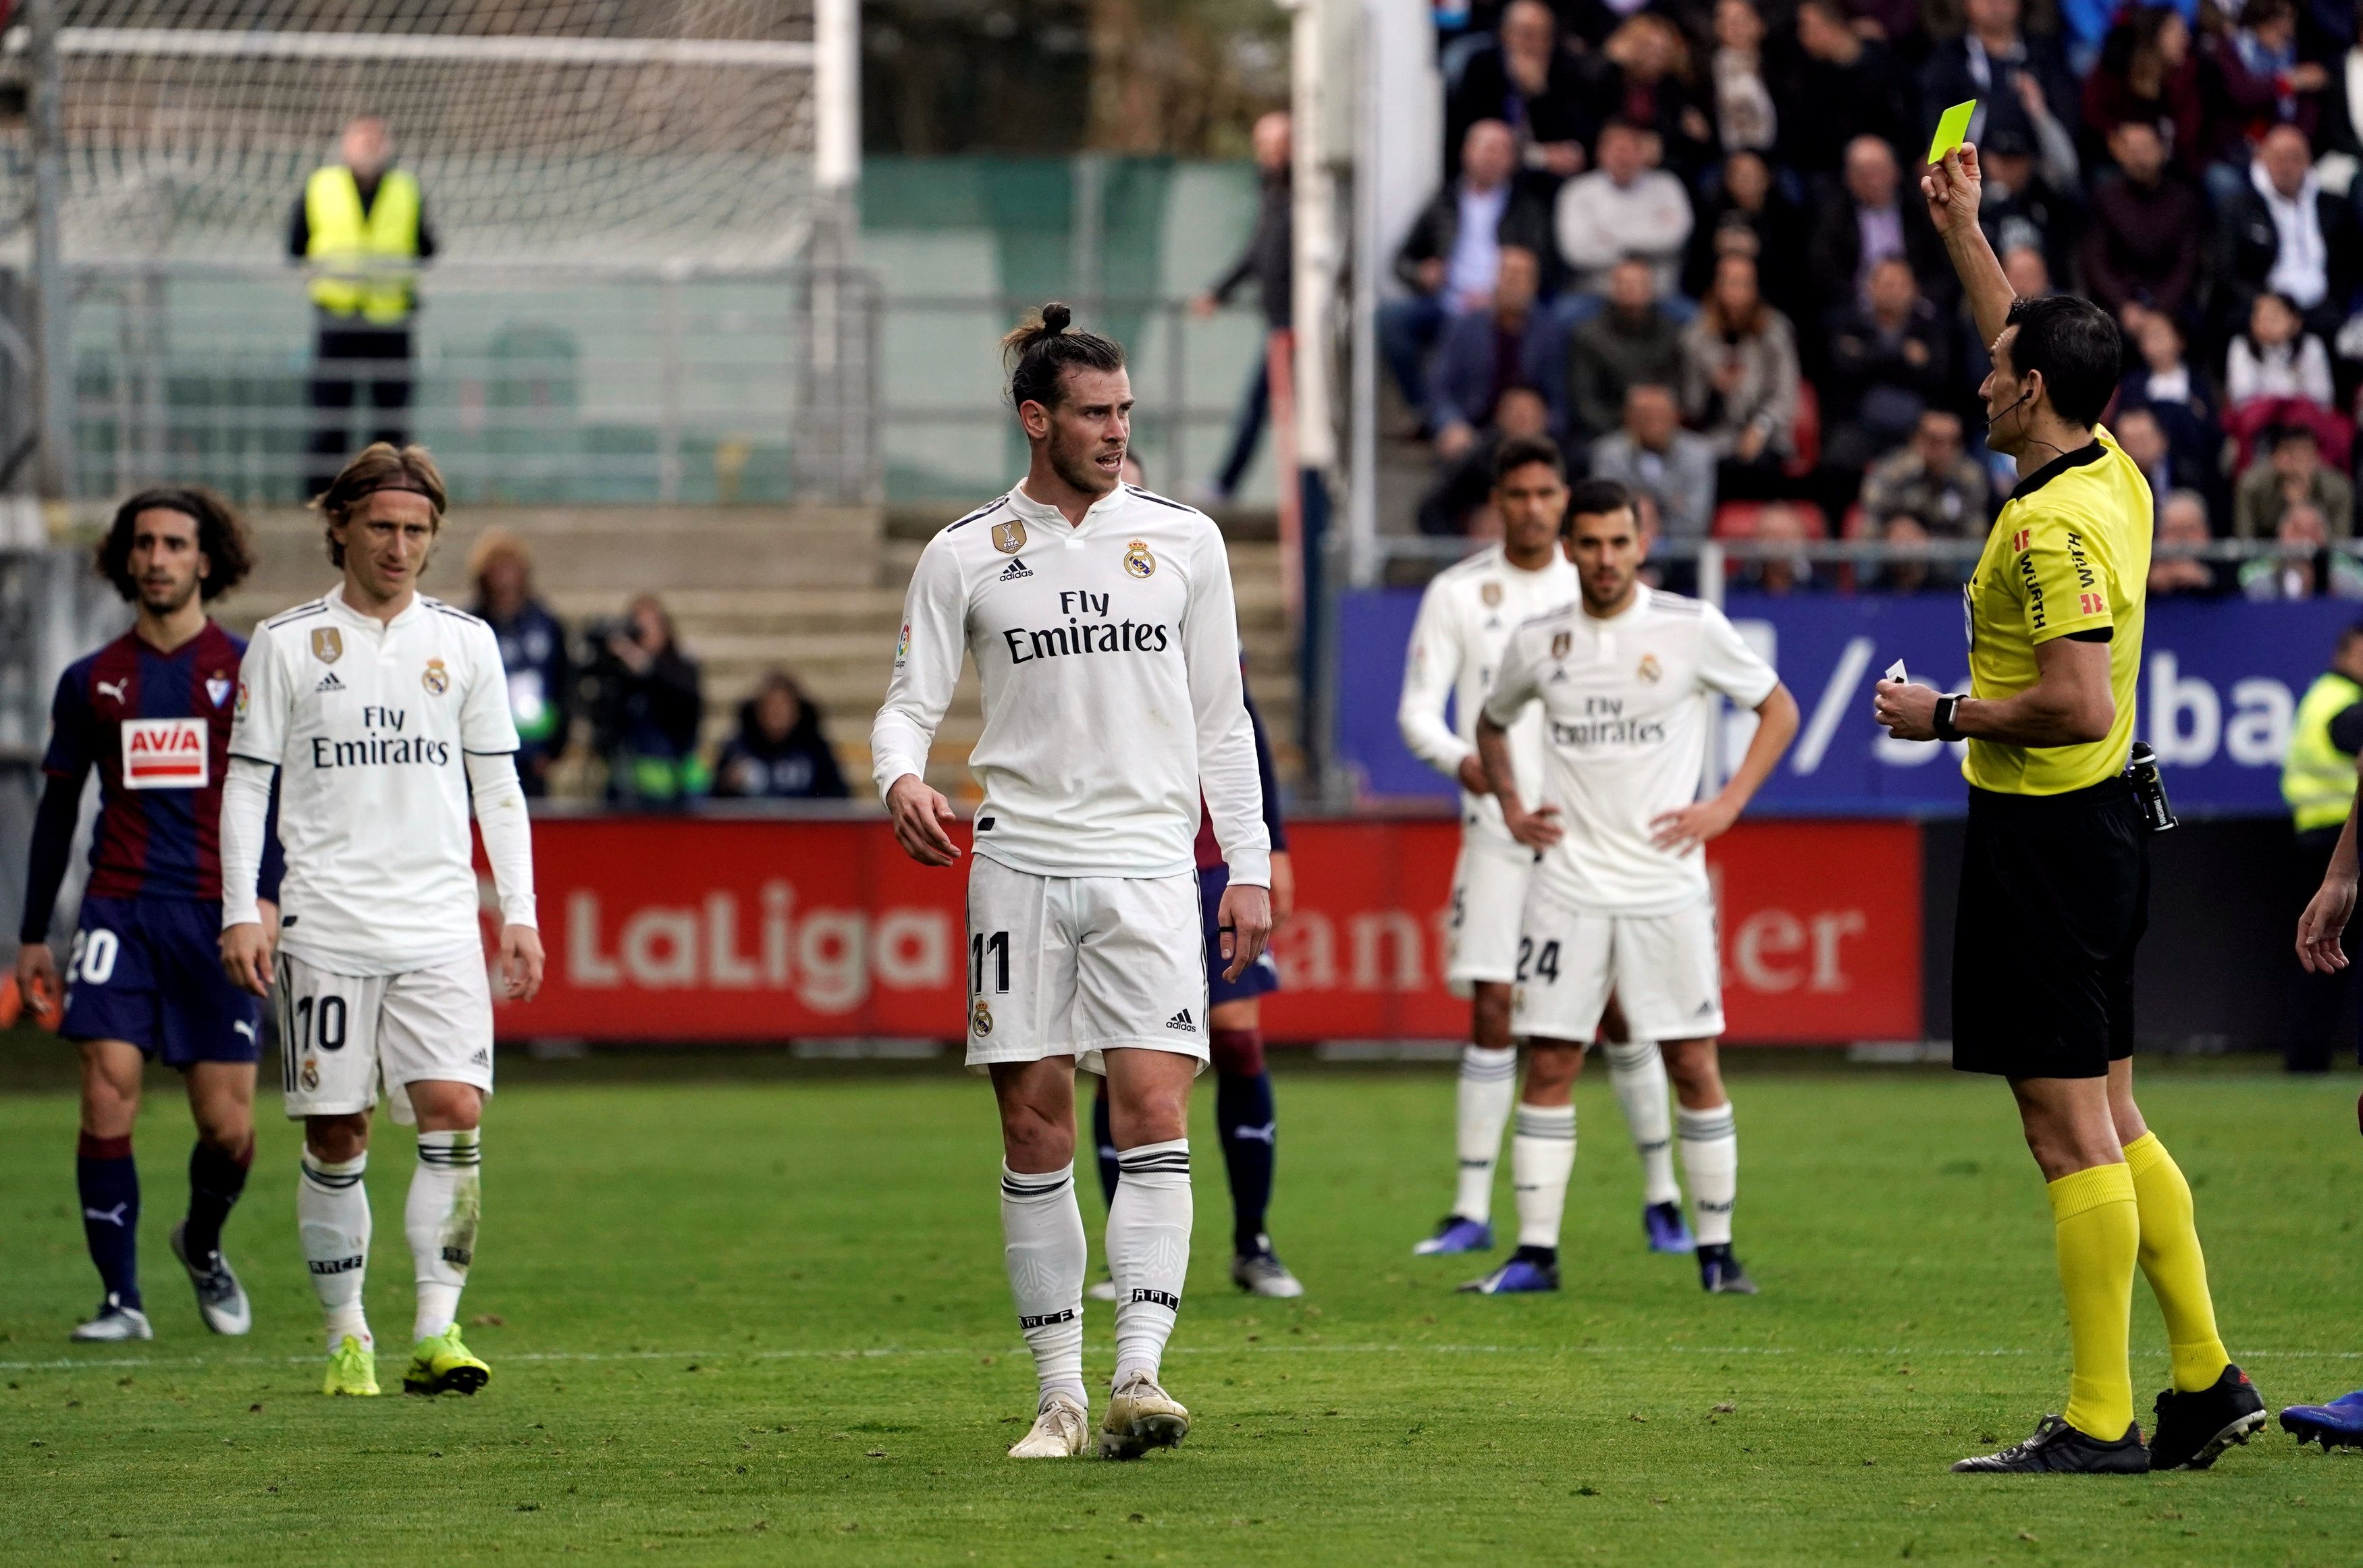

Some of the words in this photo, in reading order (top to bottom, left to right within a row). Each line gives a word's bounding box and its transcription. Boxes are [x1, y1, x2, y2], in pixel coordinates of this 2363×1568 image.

[999, 569, 1034, 582] adidas
[2019, 553, 2046, 630] WÜRTH
[1059, 590, 1109, 618] Fly
[1002, 617, 1167, 665] Emirates
[363, 705, 404, 732] Fly
[311, 731, 450, 769] Emirates
[568, 880, 950, 1012] LaLiga
[972, 931, 1009, 996] 11
[1516, 936, 1560, 985] 24
[296, 995, 346, 1052] 10
[1165, 1020, 1197, 1033] adidas
